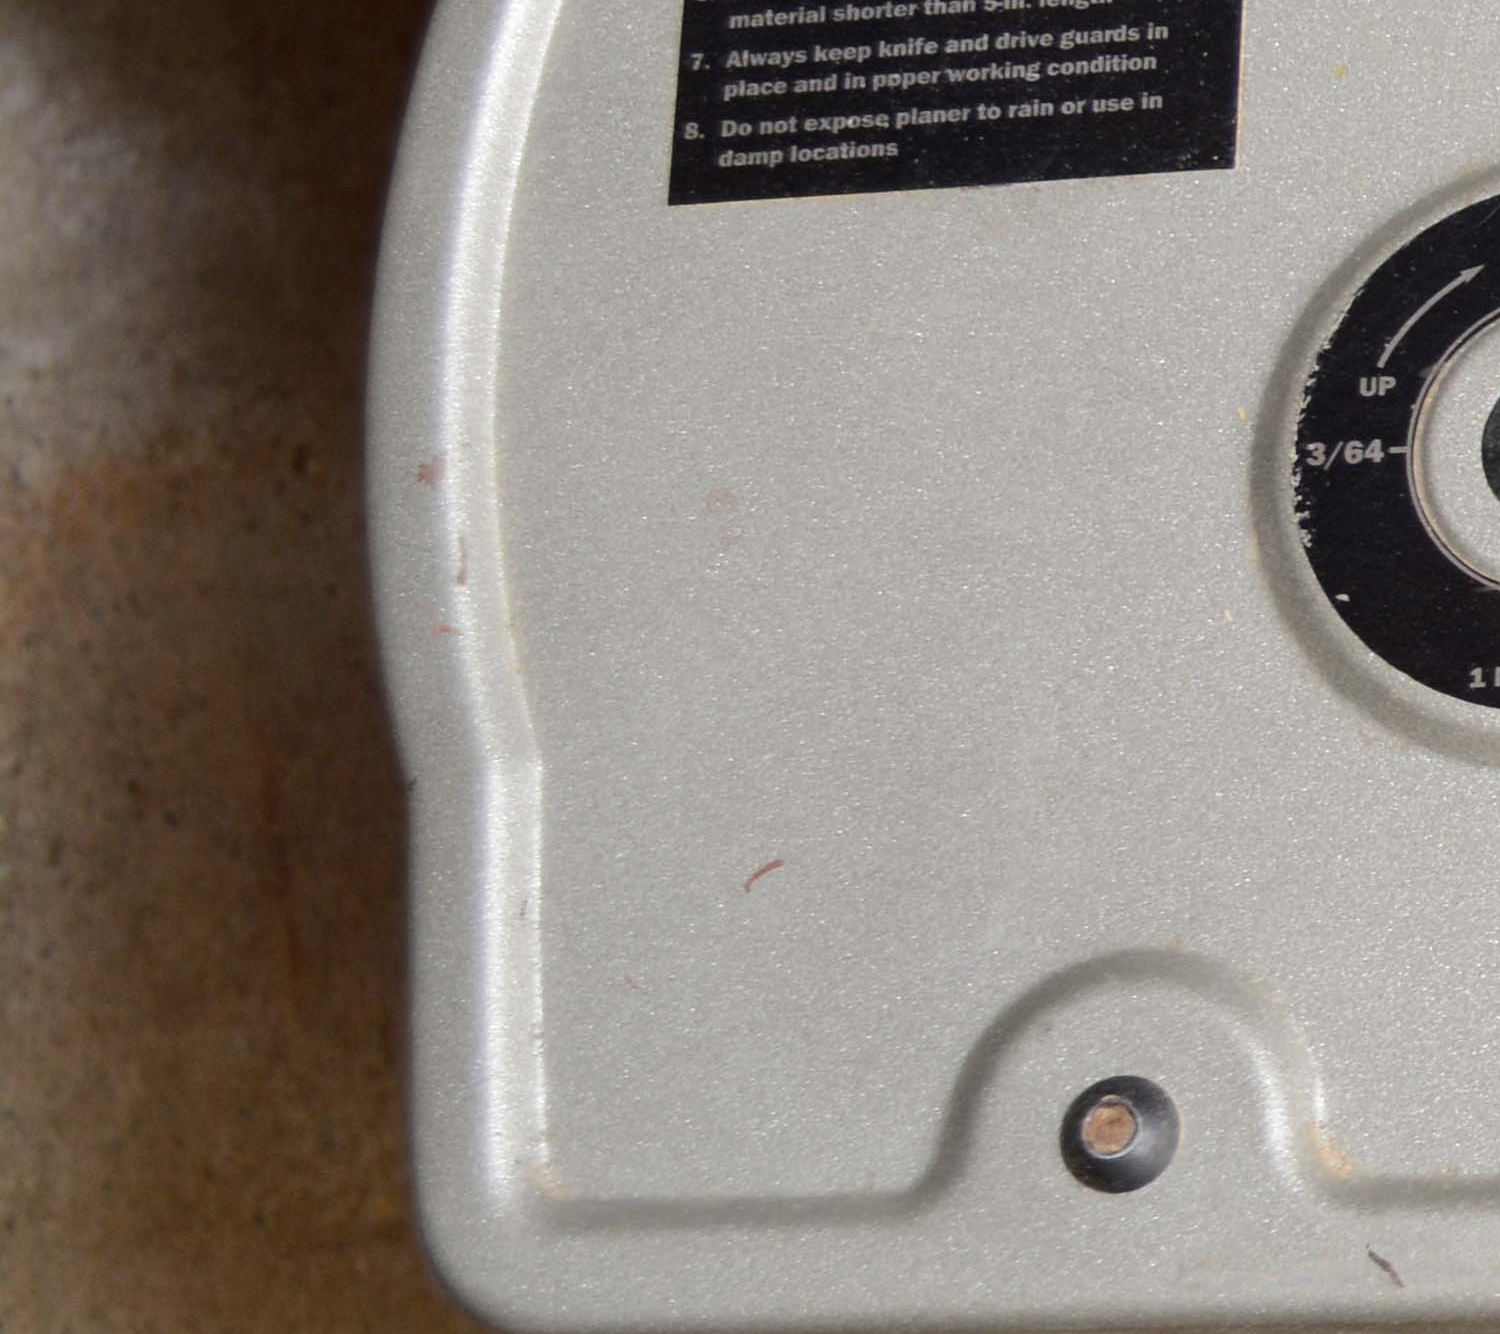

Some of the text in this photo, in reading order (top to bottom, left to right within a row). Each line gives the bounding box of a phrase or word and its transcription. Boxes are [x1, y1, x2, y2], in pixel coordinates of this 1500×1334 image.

[729, 5, 826, 29] material
[832, 1, 918, 22] shorter
[690, 22, 1169, 71] 7. Always keep knife and drive guards in
[723, 79, 787, 102] place
[793, 73, 838, 93] and
[844, 72, 867, 90] in
[947, 61, 1041, 83] working
[1047, 53, 1157, 77] condition
[684, 91, 1163, 140] 8. Do not expose planer to rain or use in
[718, 141, 899, 168] damp locations
[1360, 377, 1395, 397] UP
[1306, 442, 1384, 469] 3/64
